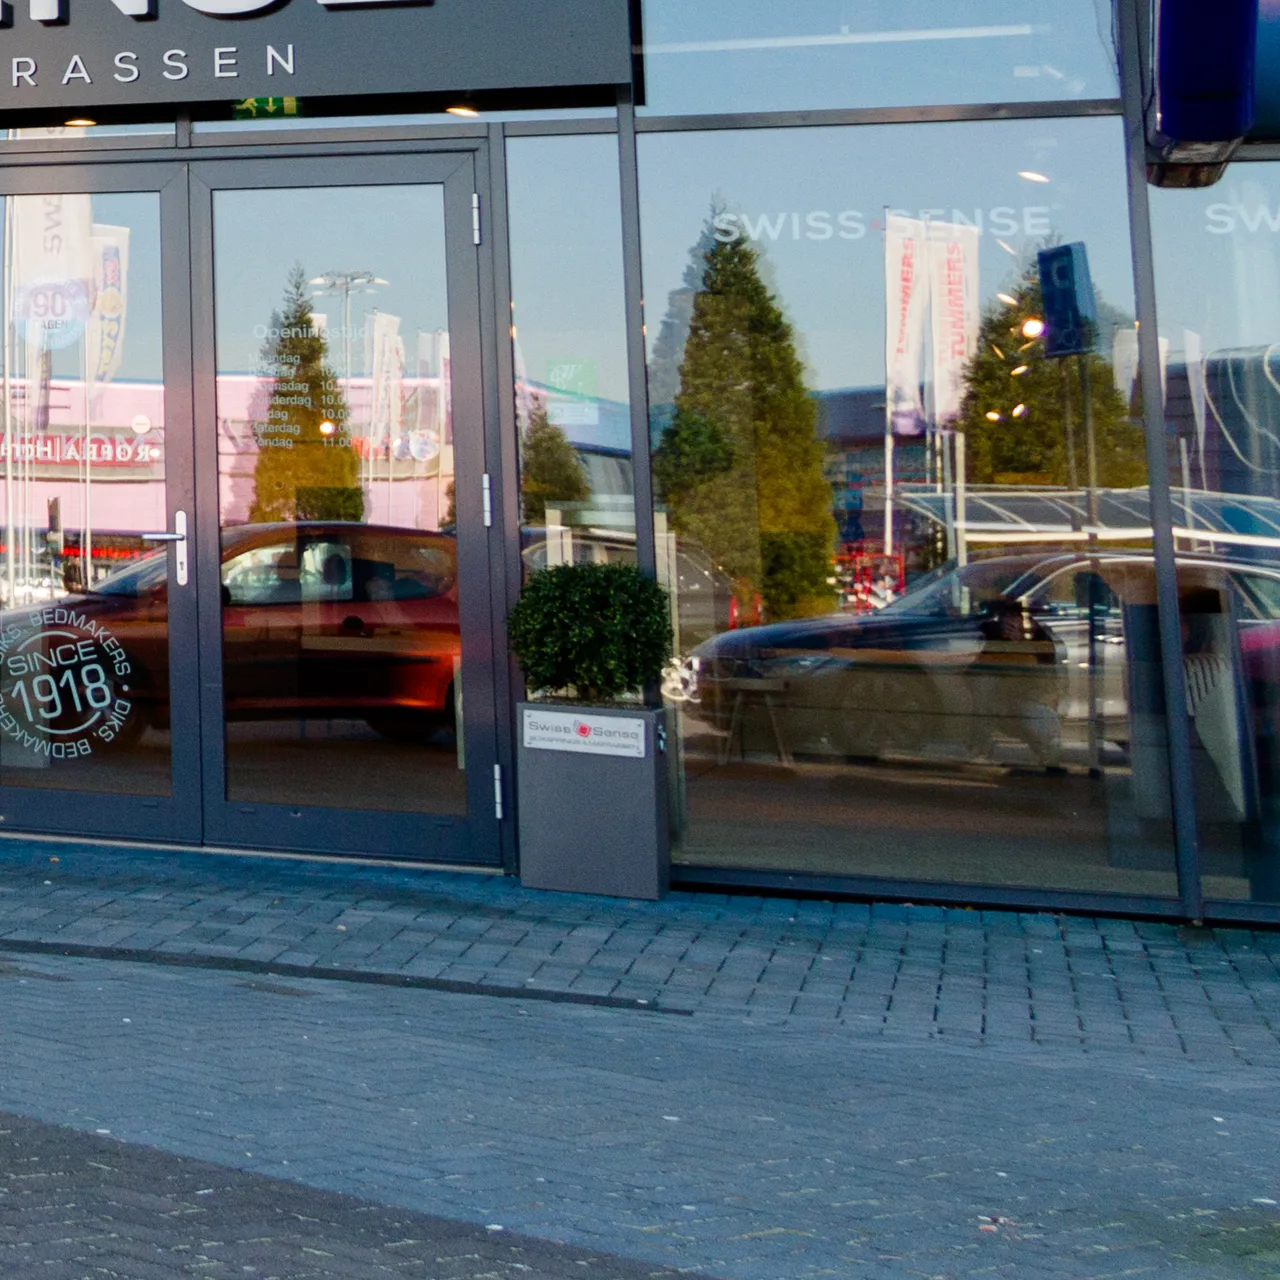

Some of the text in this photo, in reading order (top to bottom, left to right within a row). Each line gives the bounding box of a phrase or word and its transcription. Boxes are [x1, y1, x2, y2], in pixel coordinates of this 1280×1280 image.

[712, 206, 1051, 242] SWISS SENSE
[32, 291, 67, 318] 90
[6, 639, 99, 677] SINCE
[28, 608, 132, 676] BEDMAKERS
[10, 662, 113, 723] 1918
[528, 720, 572, 734] Swiss
